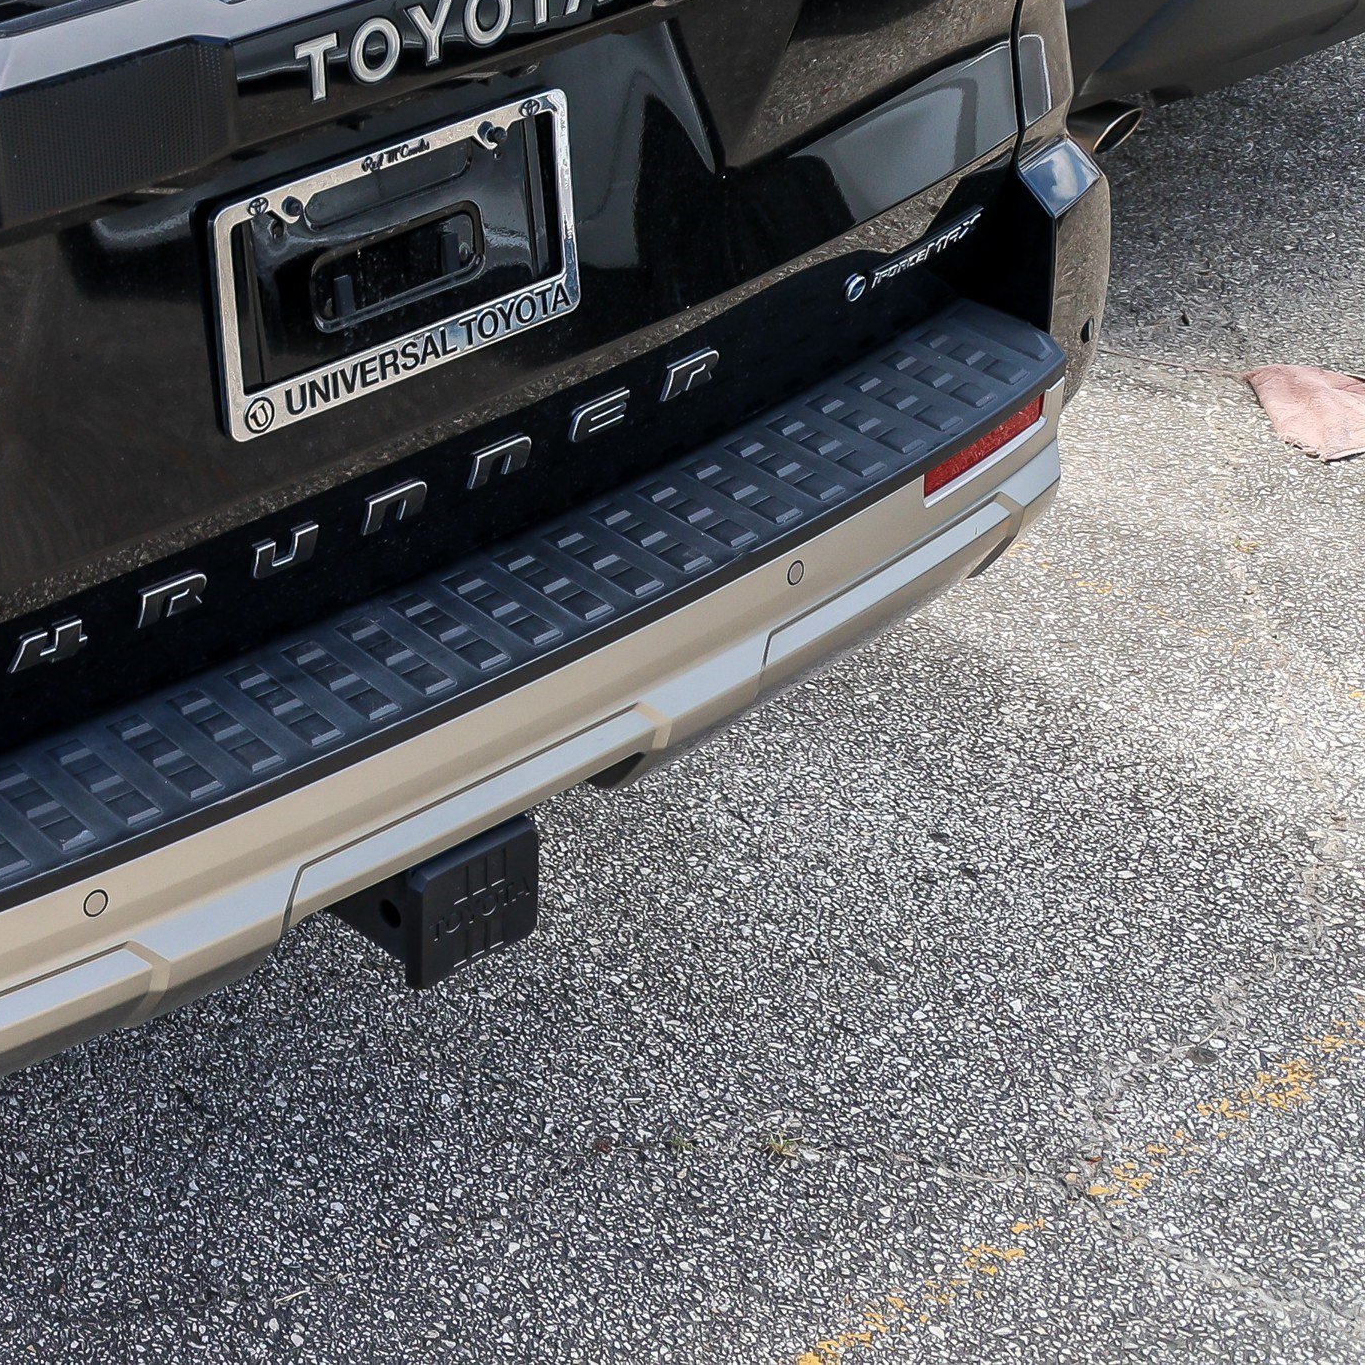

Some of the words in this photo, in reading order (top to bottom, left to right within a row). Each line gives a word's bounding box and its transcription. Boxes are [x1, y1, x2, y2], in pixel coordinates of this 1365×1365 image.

[284, 326, 458, 416] UNIVERSAL
[459, 281, 571, 347] TOYOTA
[428, 876, 530, 942] TOYOTA
